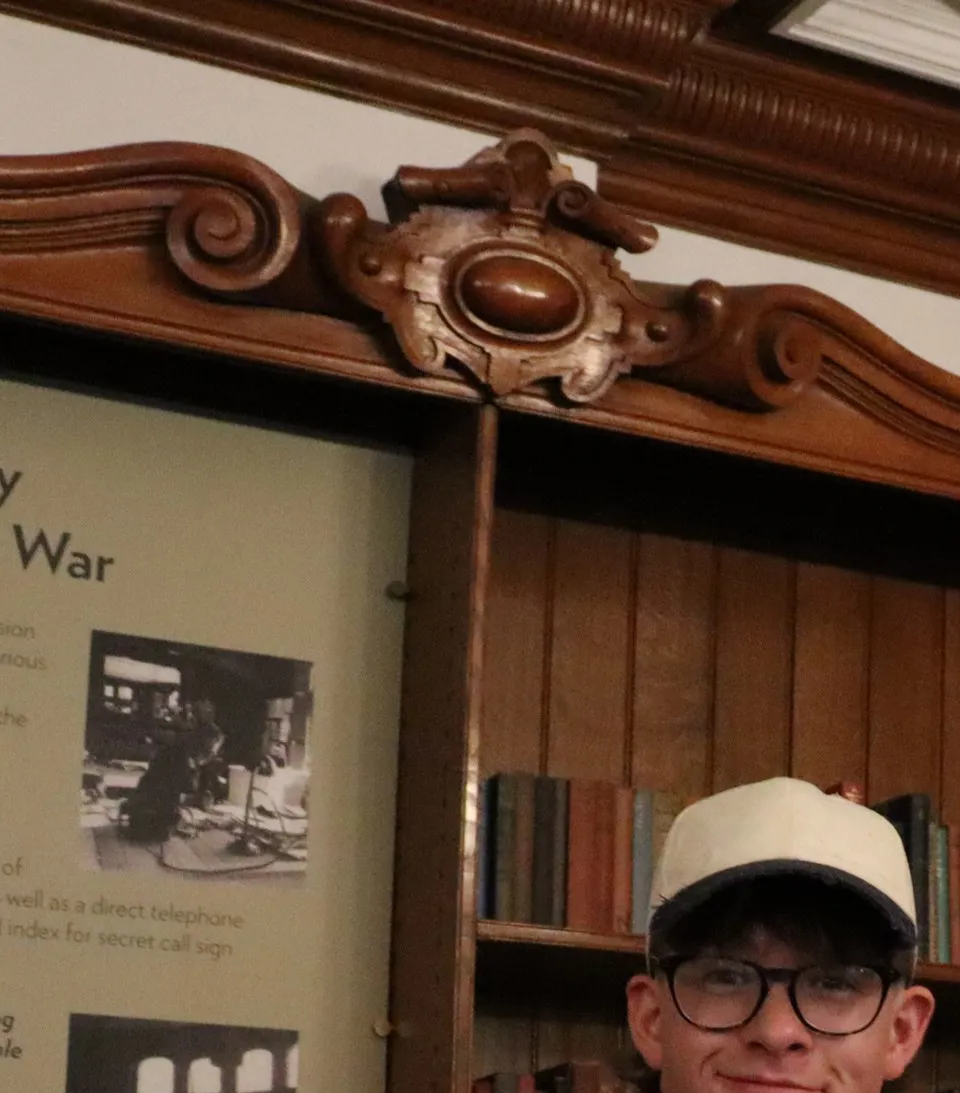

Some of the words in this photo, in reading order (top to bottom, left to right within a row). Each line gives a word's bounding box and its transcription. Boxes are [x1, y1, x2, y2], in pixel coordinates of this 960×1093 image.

[13, 523, 115, 582] War
[1, 856, 23, 876] of
[5, 889, 43, 909] well
[50, 897, 69, 912] as
[74, 900, 86, 915] a
[91, 894, 145, 920] direct
[151, 901, 244, 929] telephone
[8, 919, 60, 940] index
[66, 921, 91, 943] for
[98, 932, 155, 950] secret
[160, 934, 191, 952] call
[196, 939, 233, 962] sign
